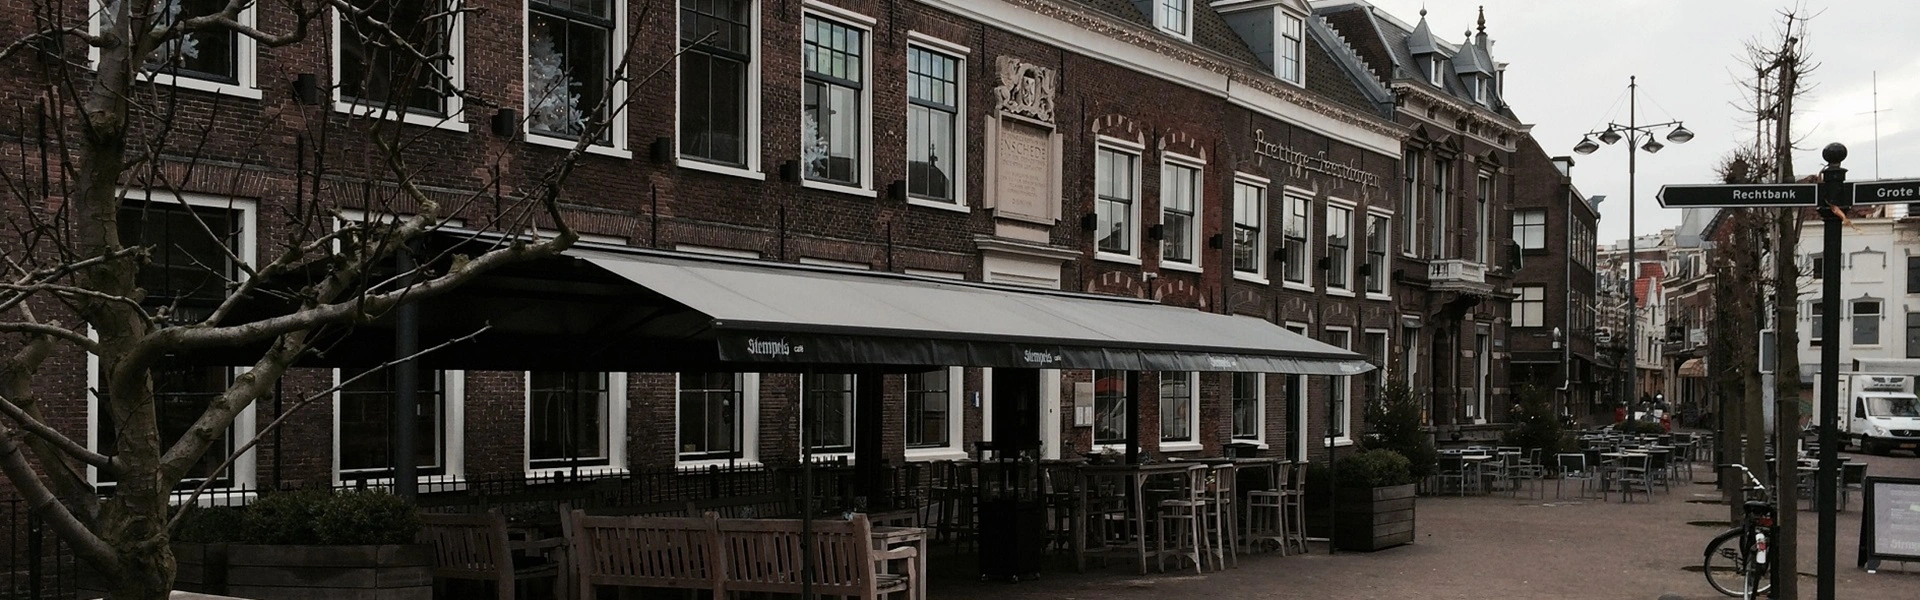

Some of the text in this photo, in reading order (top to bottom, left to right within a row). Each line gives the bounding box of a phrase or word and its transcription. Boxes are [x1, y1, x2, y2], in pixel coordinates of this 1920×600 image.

[1254, 128, 1381, 195] Prettige Feestdagen
[1732, 189, 1797, 200] Rechtbank
[1876, 187, 1914, 198] Grote
[747, 336, 790, 359] Stempels
[1023, 348, 1053, 366] Stempels
